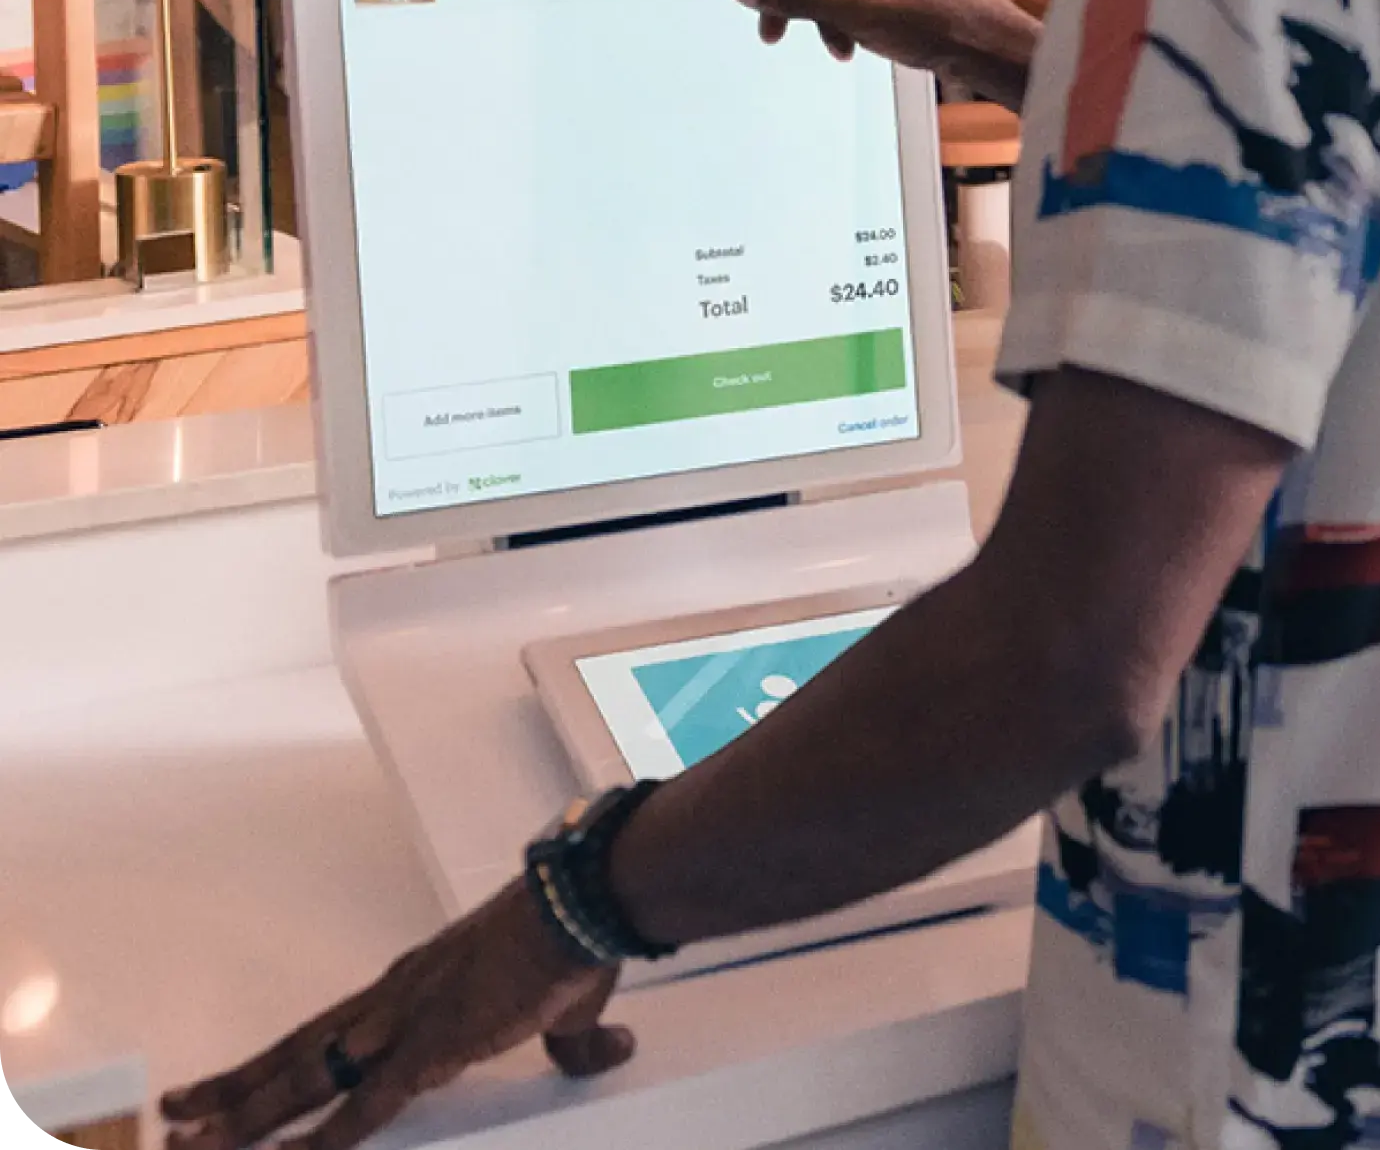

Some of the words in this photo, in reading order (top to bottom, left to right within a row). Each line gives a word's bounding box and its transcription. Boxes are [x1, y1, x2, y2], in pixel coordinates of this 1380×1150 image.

[695, 245, 744, 261] Subtotal
[697, 273, 731, 286] Taxes
[700, 295, 749, 318] Total
[829, 278, 900, 303] $24.40
[712, 372, 750, 388] Check
[752, 369, 773, 384] out
[423, 413, 449, 427] Add
[451, 409, 484, 423] more
[837, 416, 877, 434] Cancel
[879, 413, 908, 429] order
